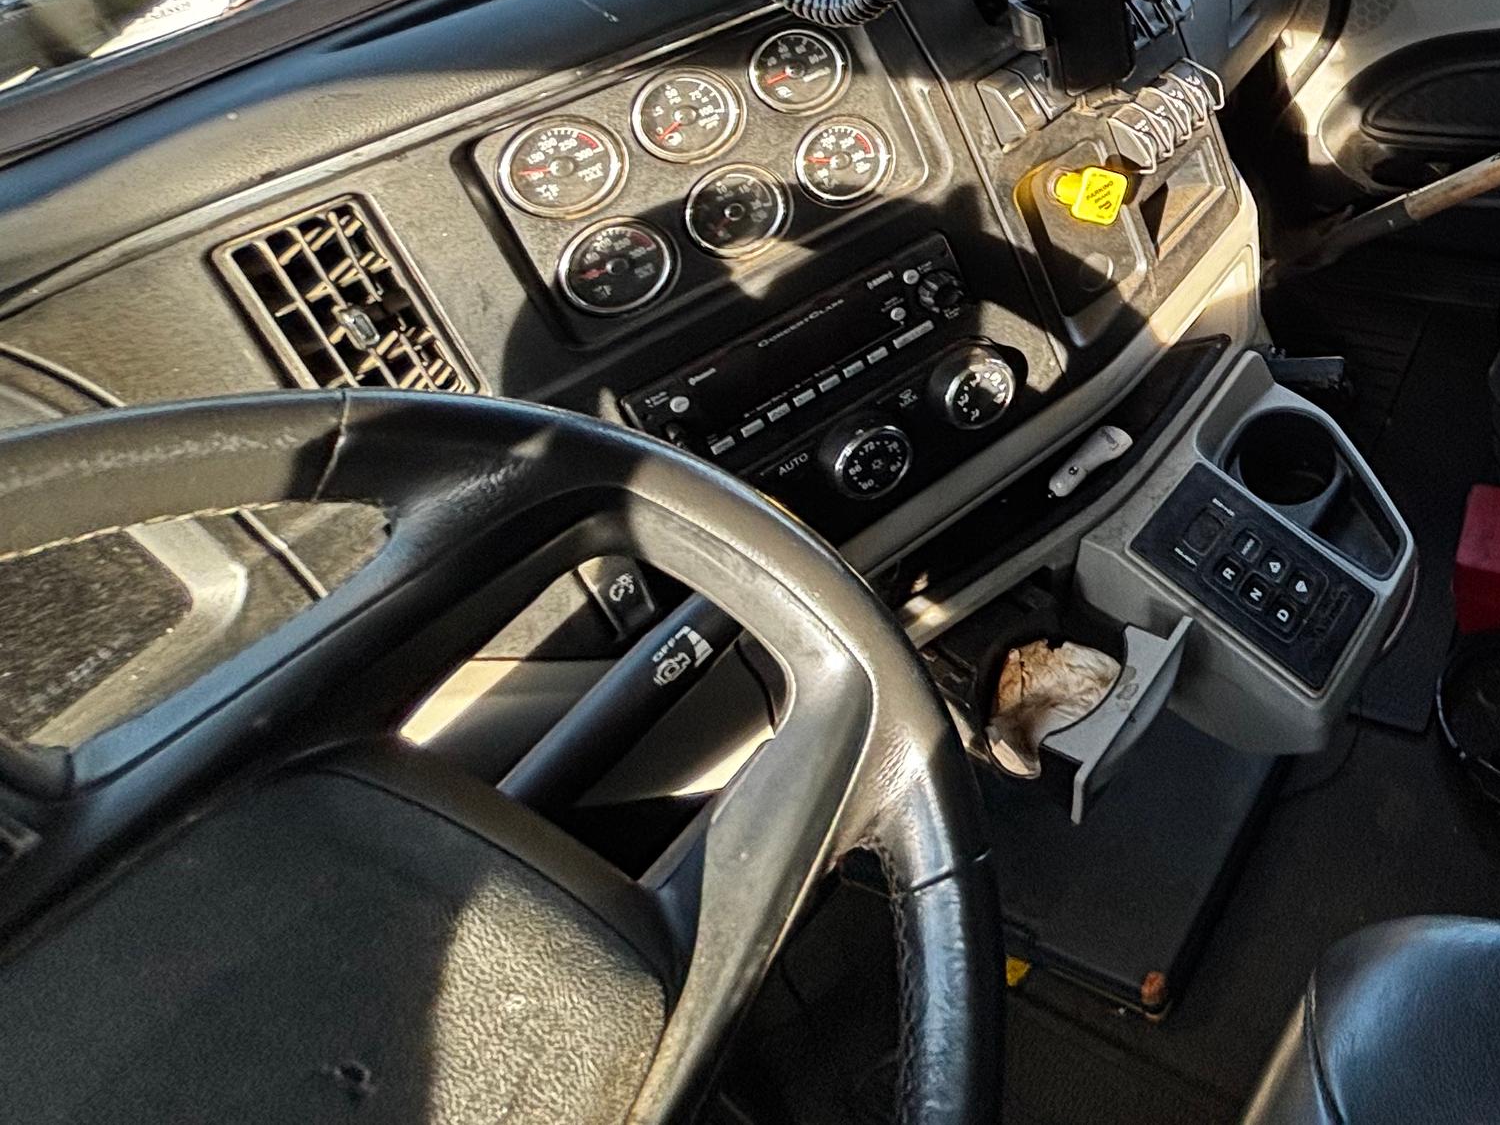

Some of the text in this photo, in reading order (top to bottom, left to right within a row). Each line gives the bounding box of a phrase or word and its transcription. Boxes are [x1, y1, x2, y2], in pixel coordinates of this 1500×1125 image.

[538, 137, 558, 151] 200
[558, 138, 578, 151] 250
[574, 148, 594, 161] 300
[1086, 180, 1114, 201] PARKING
[778, 452, 809, 476] AUTO
[1222, 567, 1236, 581] R
[1249, 587, 1263, 602] N
[1276, 609, 1289, 623] D
